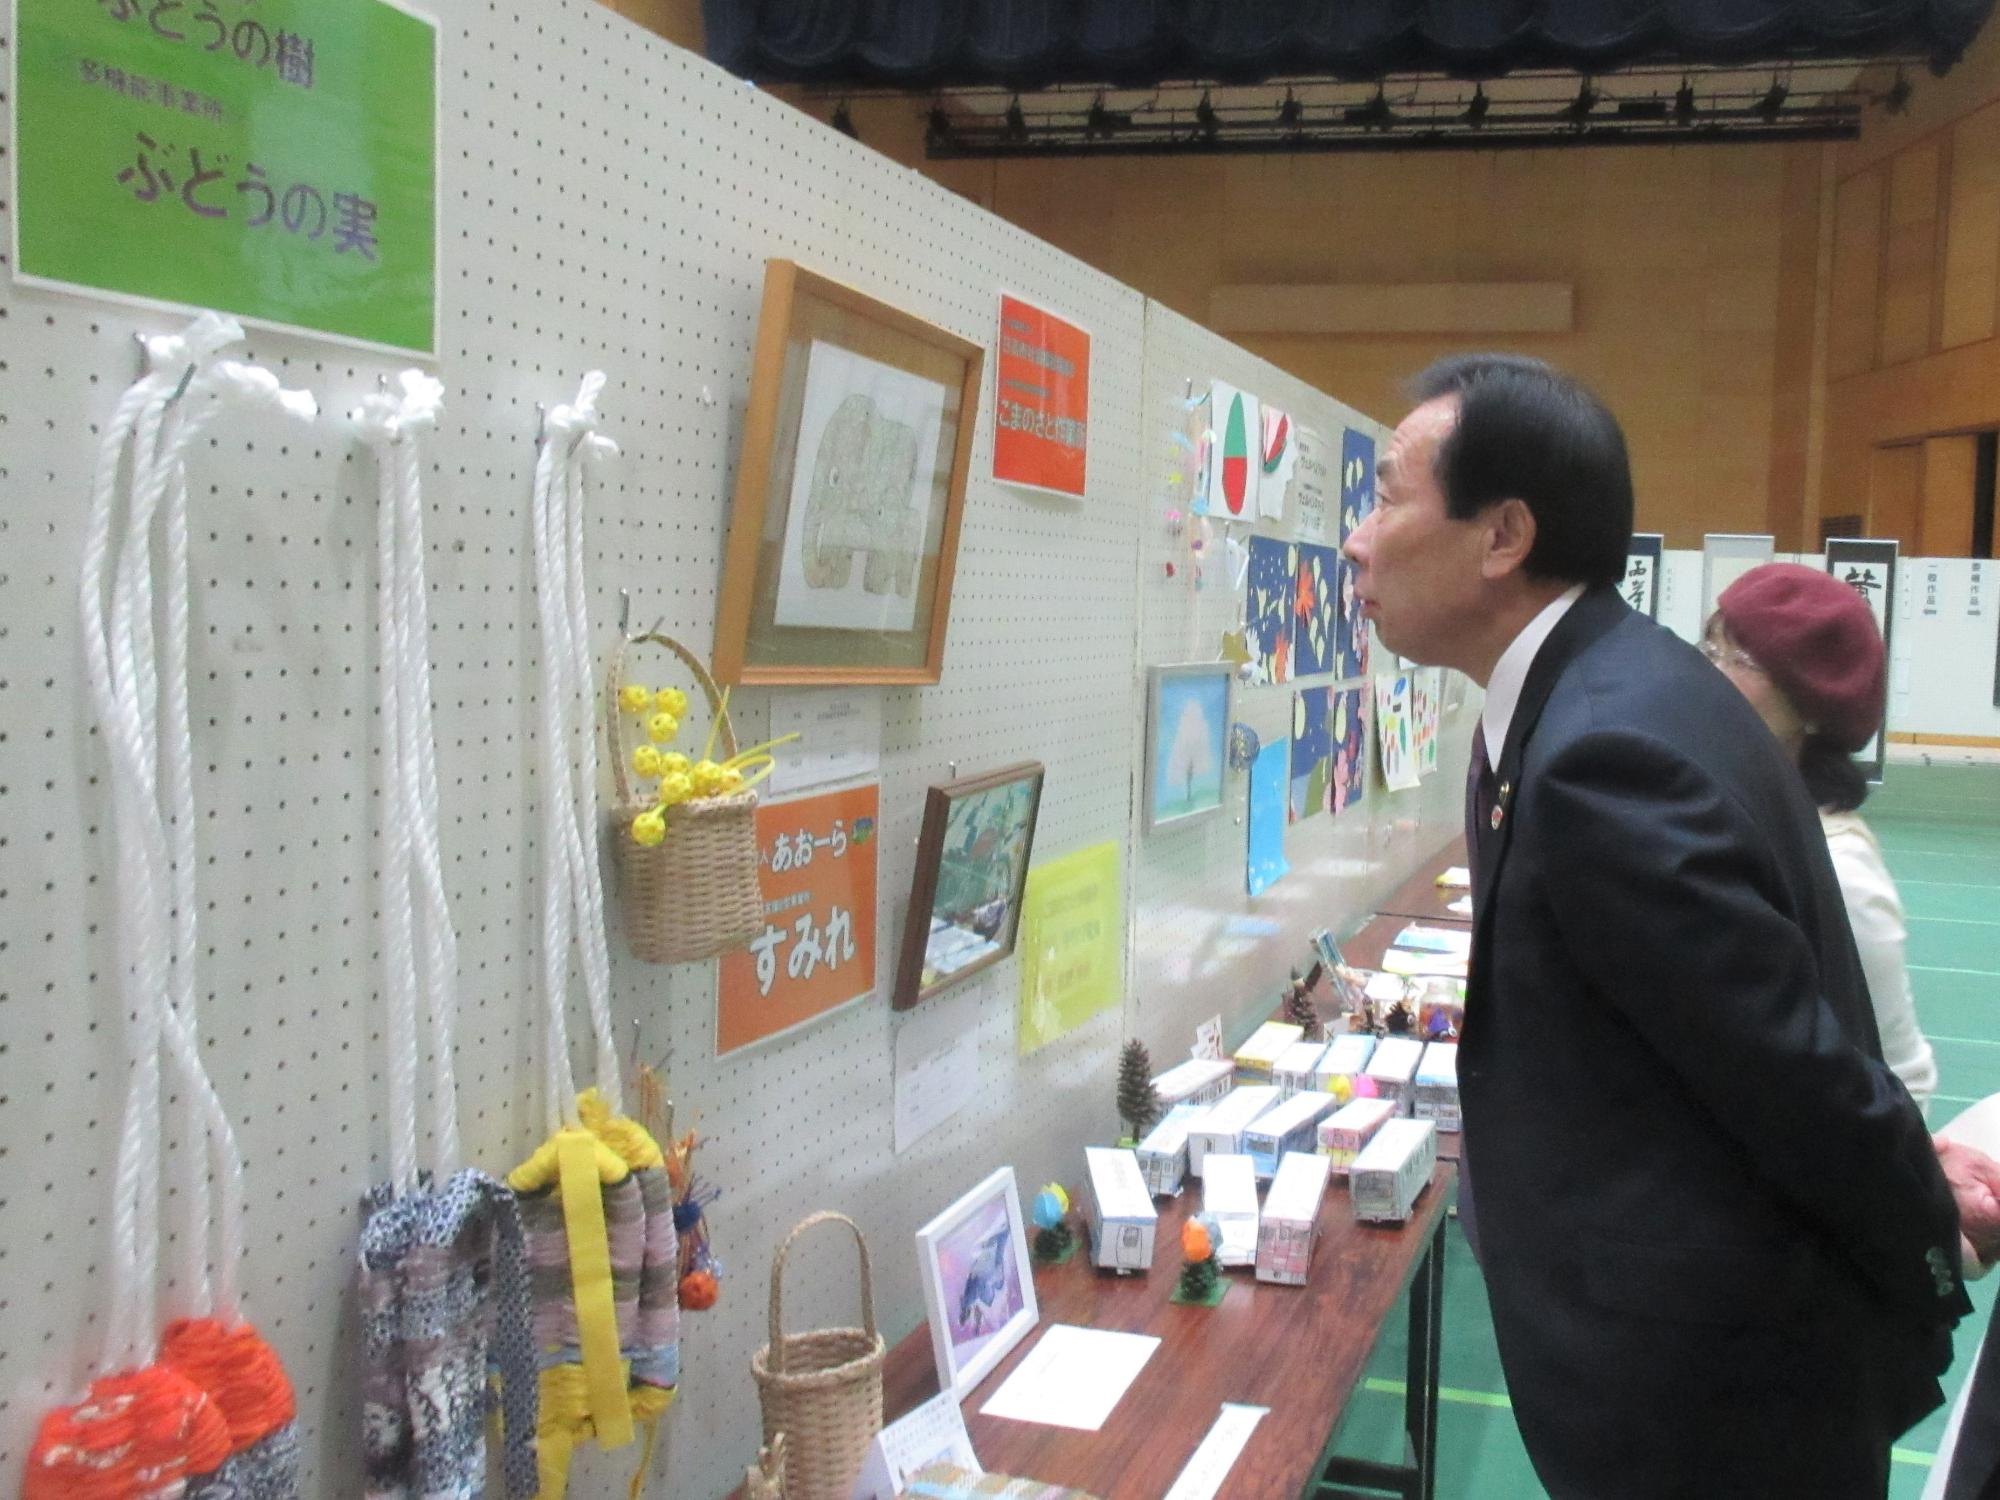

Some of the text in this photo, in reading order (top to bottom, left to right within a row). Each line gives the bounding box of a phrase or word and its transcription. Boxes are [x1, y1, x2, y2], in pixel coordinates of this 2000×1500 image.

[117, 131, 378, 262] ぶどうの実
[772, 819, 848, 873] あおーら
[749, 906, 855, 997] すみれ
